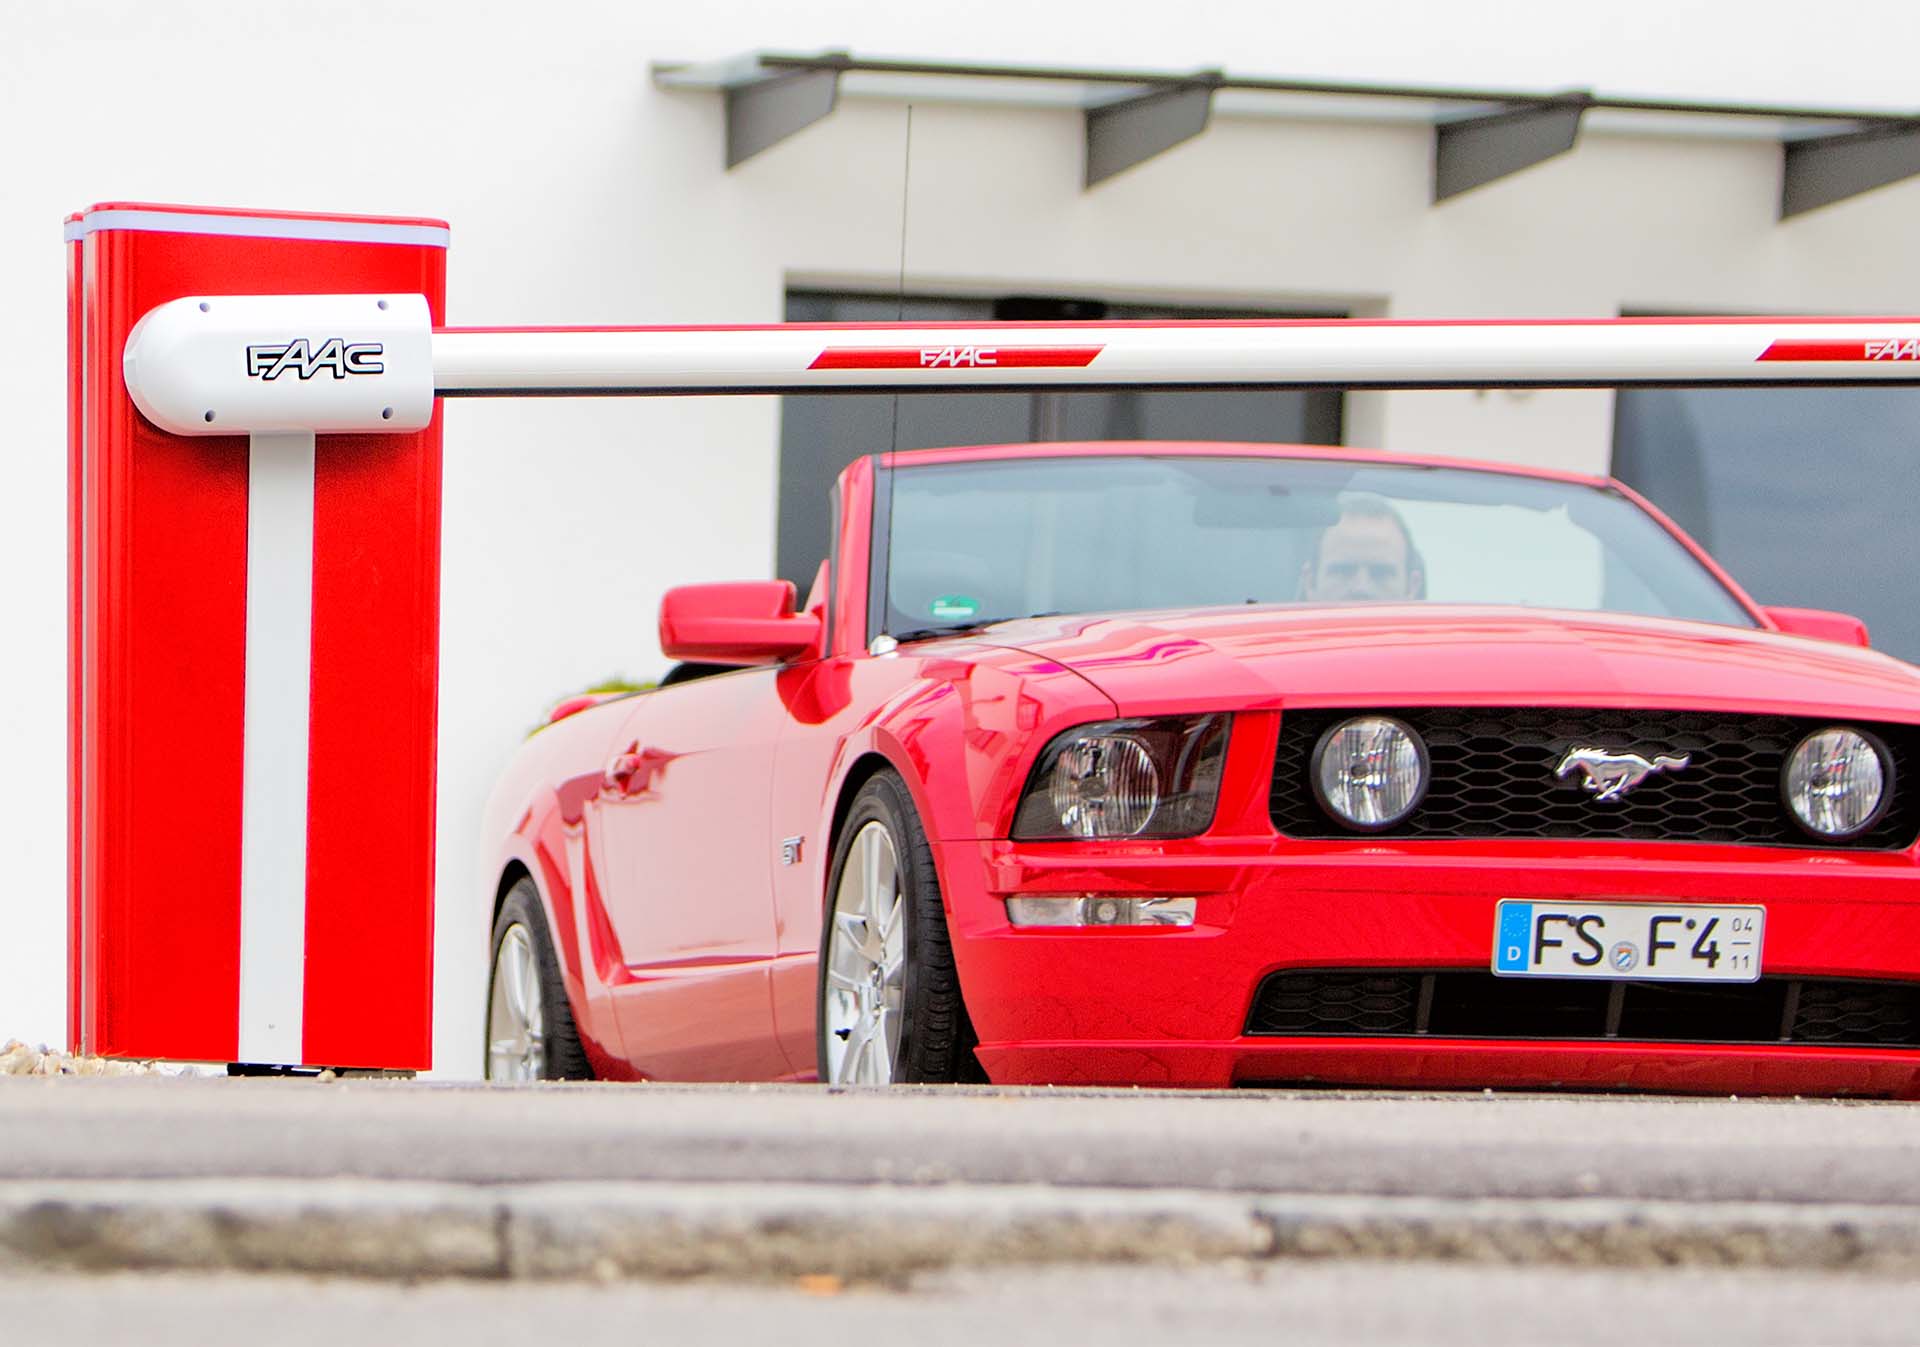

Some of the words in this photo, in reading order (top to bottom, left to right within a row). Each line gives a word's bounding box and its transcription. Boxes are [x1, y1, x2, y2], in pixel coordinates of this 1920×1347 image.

[247, 338, 384, 380] FAAC
[920, 345, 997, 367] FAAC
[1864, 338, 1920, 360] FAA
[1731, 917, 1752, 932] 04
[1534, 914, 1605, 966] FS
[1507, 946, 1521, 961] D
[1731, 955, 1750, 969] 11
